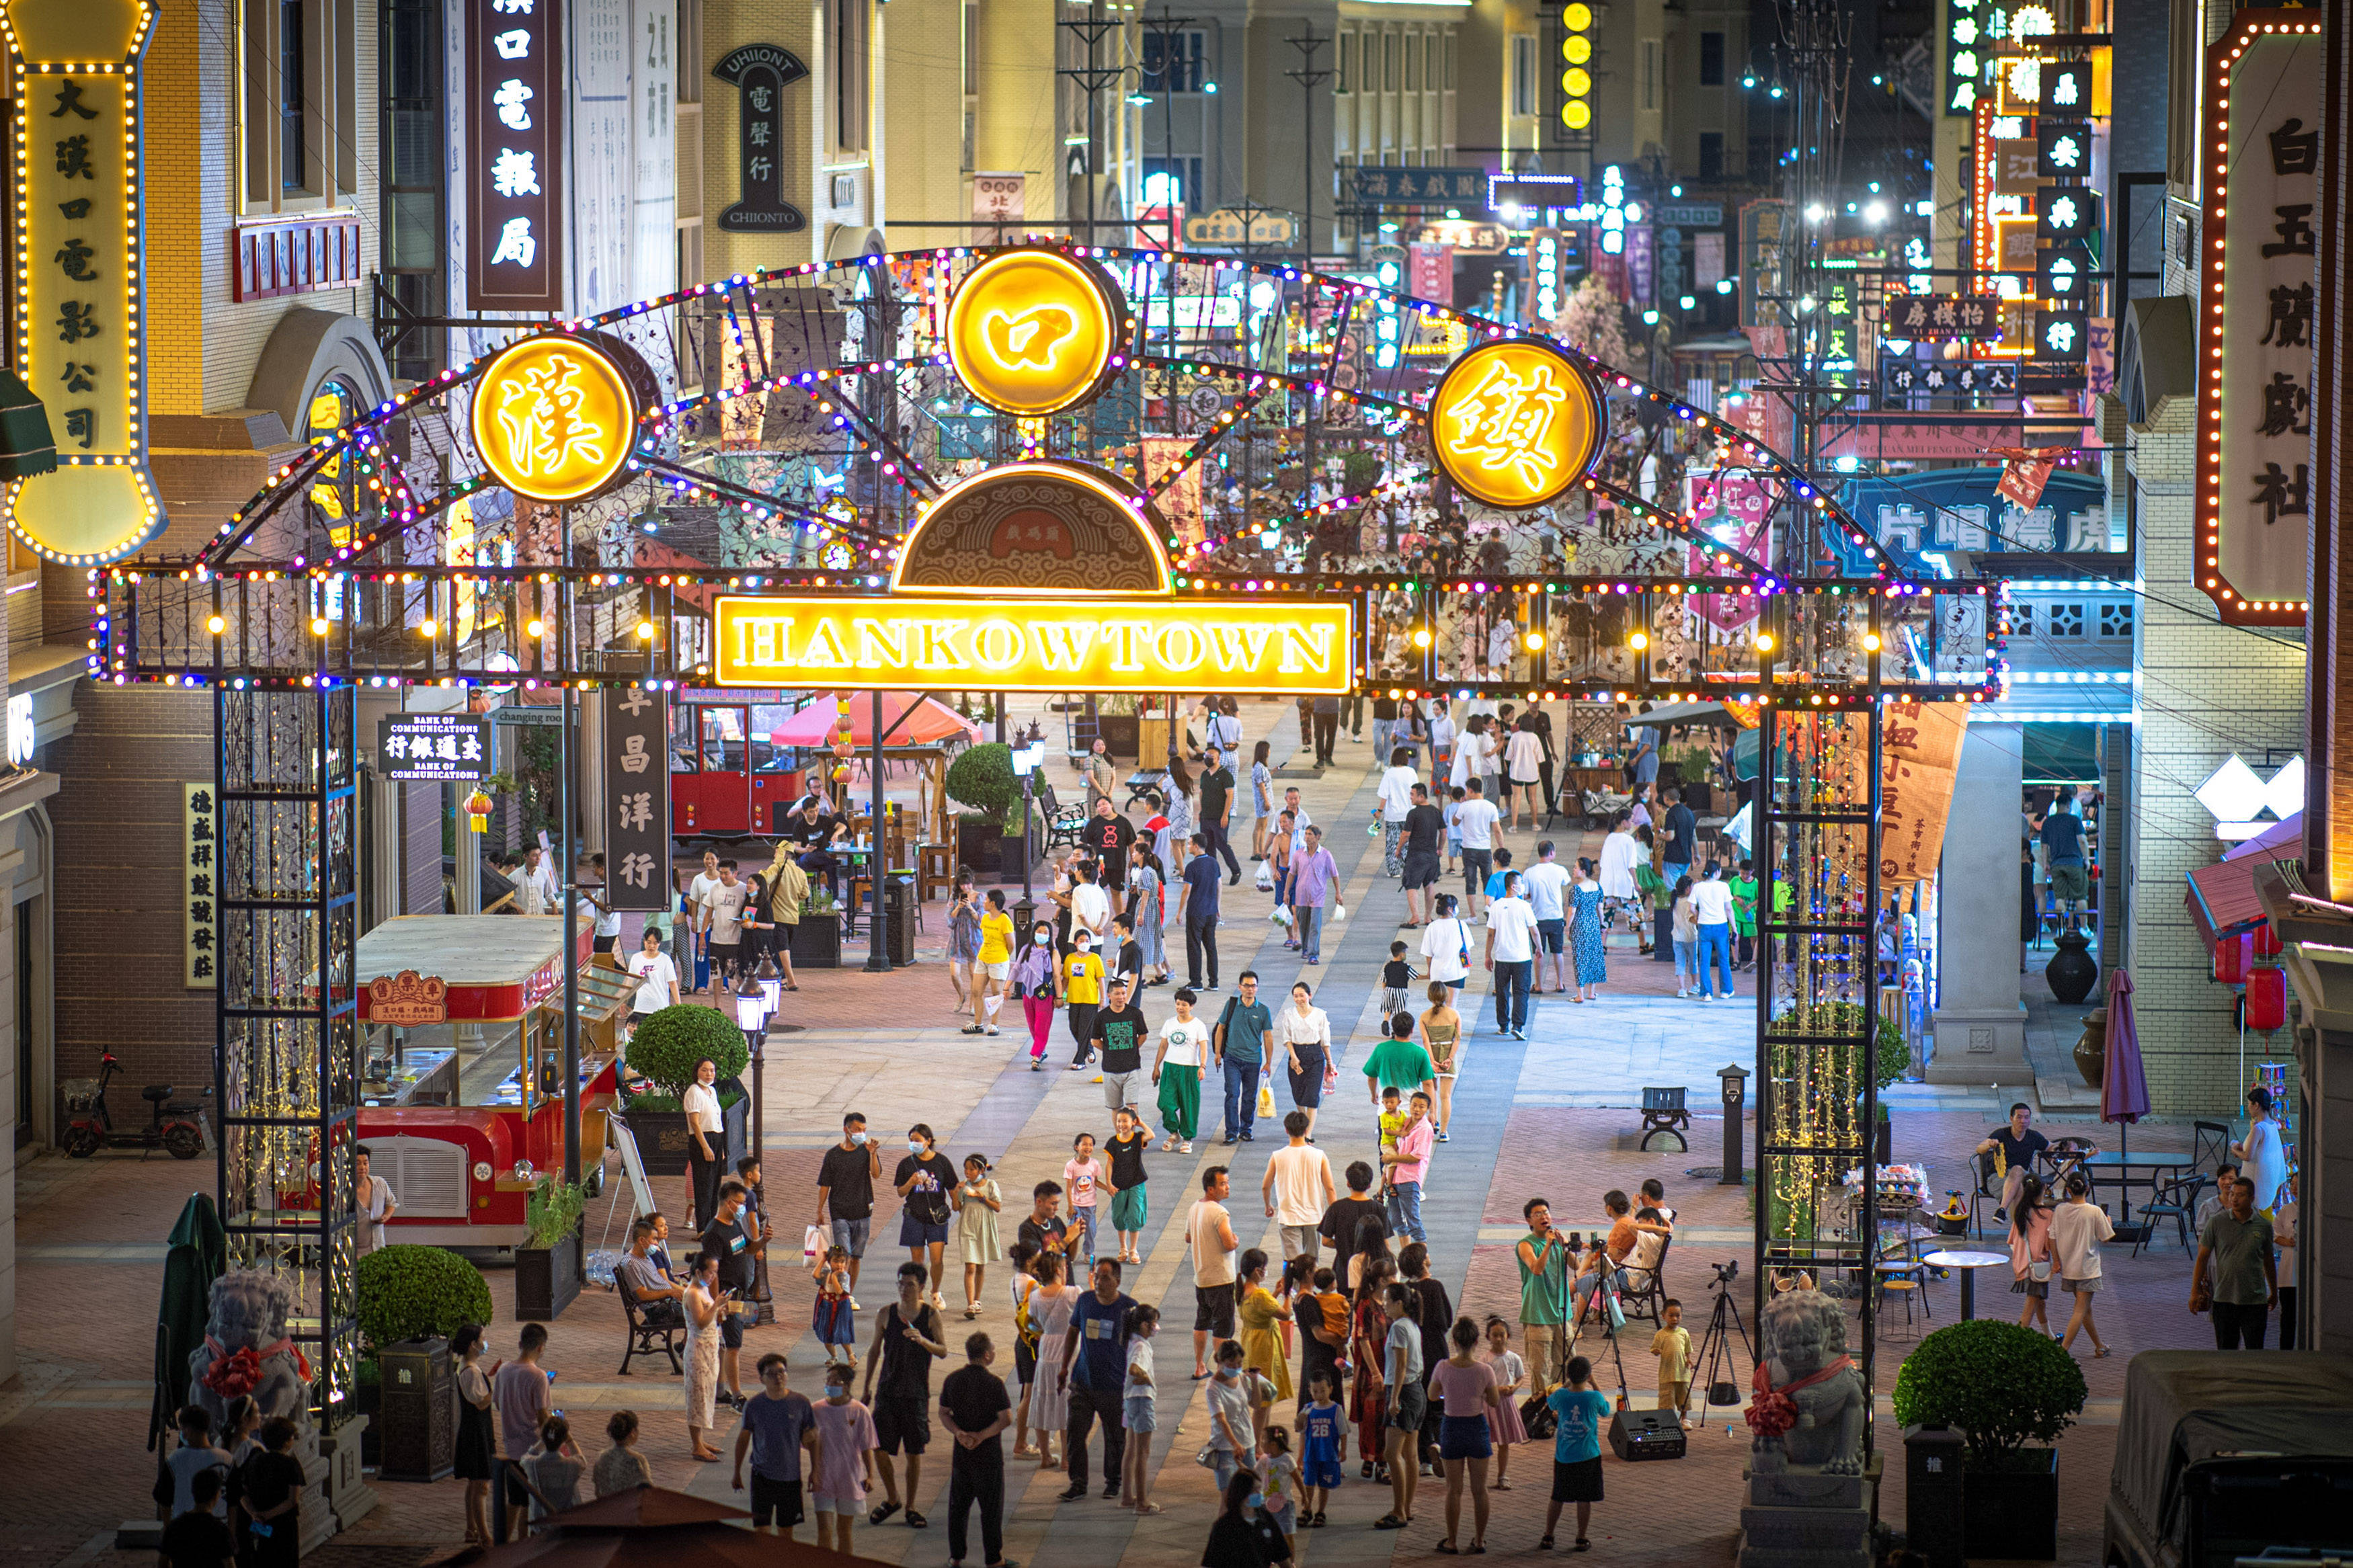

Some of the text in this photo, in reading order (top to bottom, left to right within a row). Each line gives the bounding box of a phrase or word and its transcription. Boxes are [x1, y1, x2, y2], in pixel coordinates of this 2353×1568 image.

[726, 48, 794, 73] UHIIONT
[749, 86, 772, 182] 電聲行
[729, 212, 795, 224] CHIIONTO
[50, 79, 99, 449] 大漢口電影公司
[497, 354, 605, 478] 漢
[1870, 446, 1903, 454] CUAN
[1954, 446, 1977, 454] BAN
[731, 615, 1337, 674] HANKOWTOWN
[413, 716, 456, 725] BANK OF
[499, 711, 563, 725] changing roo
[390, 725, 479, 733] COMMUNICATIONS
[414, 762, 456, 771] BANK OF
[390, 771, 479, 780] COMMUNICATIONS
[374, 975, 440, 997] 售票車
